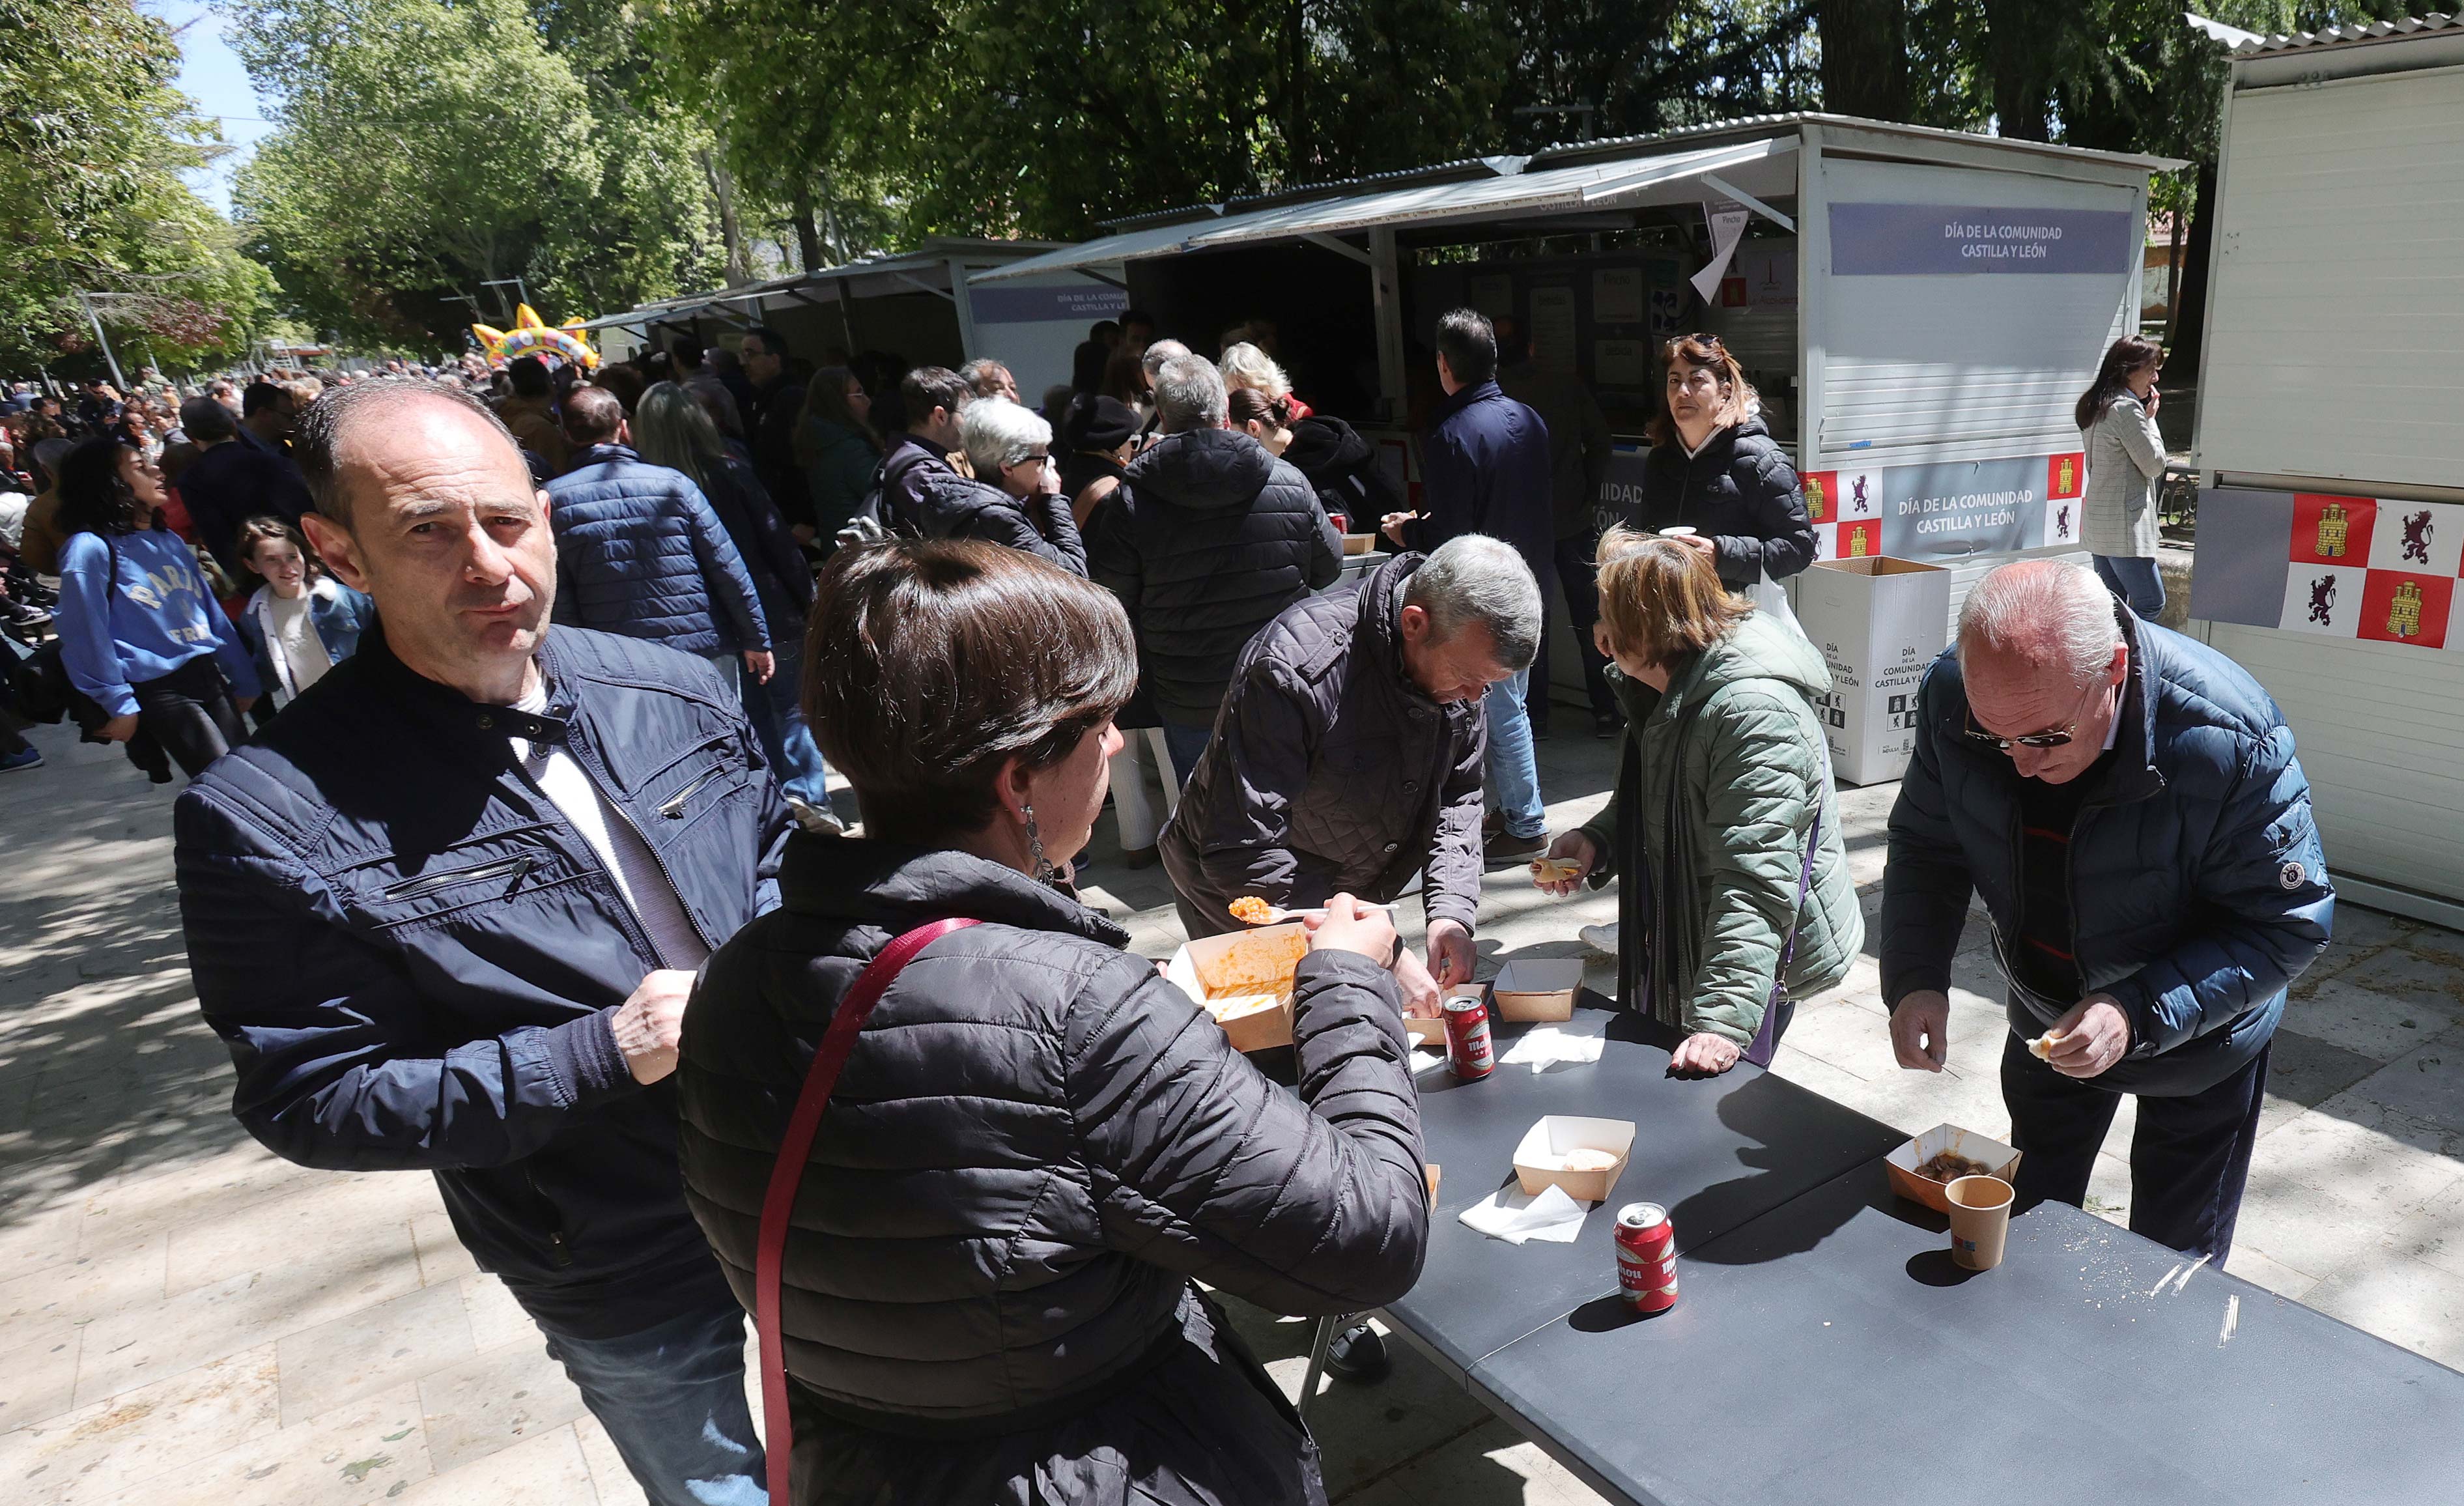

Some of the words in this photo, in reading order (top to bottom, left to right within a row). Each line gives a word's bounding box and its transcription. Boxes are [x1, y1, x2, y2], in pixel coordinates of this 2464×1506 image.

[1945, 221, 1964, 238] DÍA
[1966, 225, 1981, 238] DE
[1984, 225, 1996, 238] LA
[1998, 225, 2062, 239] COMUNIDAD
[1961, 244, 2009, 257] CASTILLA
[2010, 245, 2018, 257] Y
[2019, 242, 2046, 258] LEÓN
[1898, 497, 1921, 515] DÍA
[1923, 498, 1940, 513] DE
[1942, 496, 1957, 511] LA
[1959, 490, 2033, 509] COMUNIDAD
[1916, 515, 1972, 534] CASTILLA
[1974, 514, 1982, 528] Y
[1985, 508, 2015, 527] LEÓN
[1826, 642, 1839, 653] DÍA
[1903, 646, 1916, 656] DÍA
[1826, 660, 1853, 674] UNIDAD
[1841, 676, 1859, 687] LEÓN
[1875, 676, 1910, 688] CASTILLA
